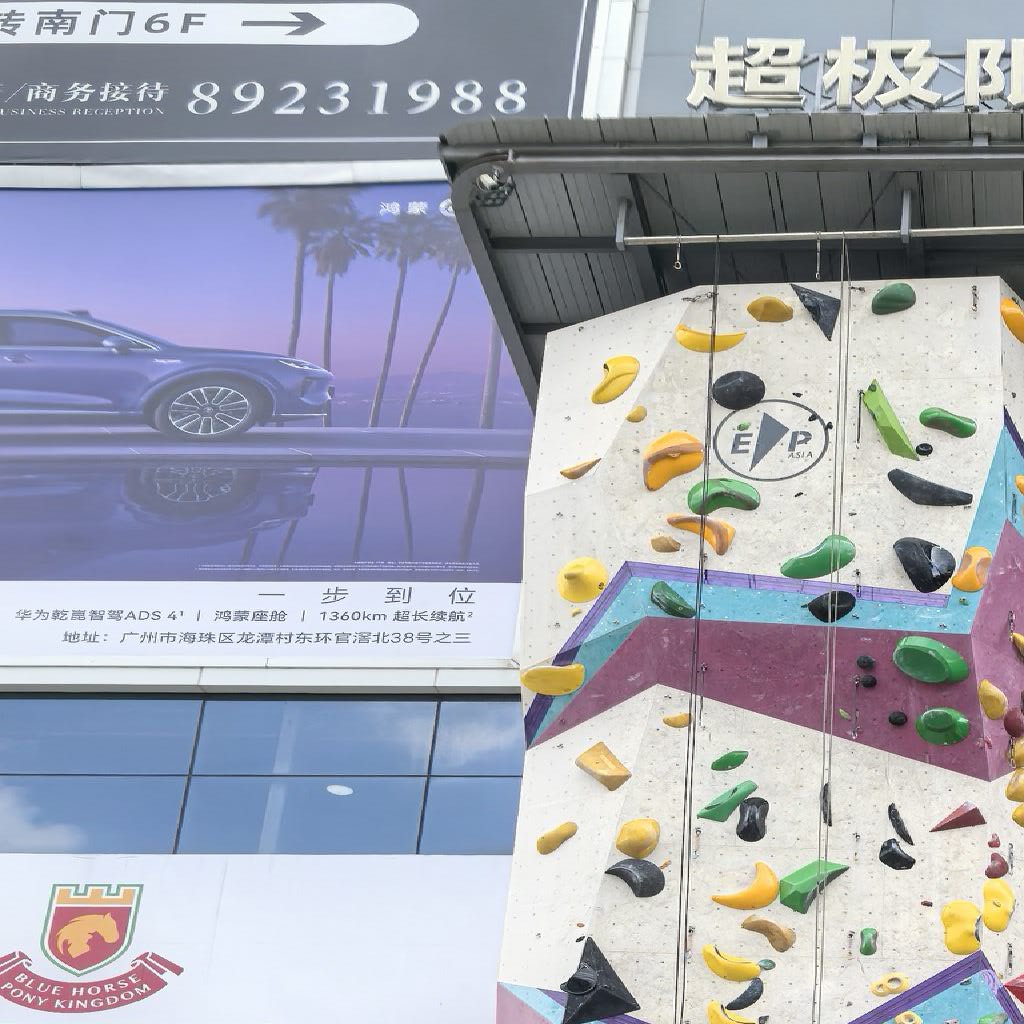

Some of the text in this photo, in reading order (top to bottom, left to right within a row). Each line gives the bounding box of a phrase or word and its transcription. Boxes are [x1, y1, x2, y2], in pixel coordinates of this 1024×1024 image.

[187, 80, 528, 115] 89231988
[379, 201, 429, 217] 鸿蒙
[788, 451, 813, 459] ASIA
[214, 610, 288, 622] 鸿蒙座舱
[319, 611, 387, 622] 1360km
[15, 972, 141, 996] BLUE HORSE
[1, 982, 152, 1009] PONY KINGDOM
